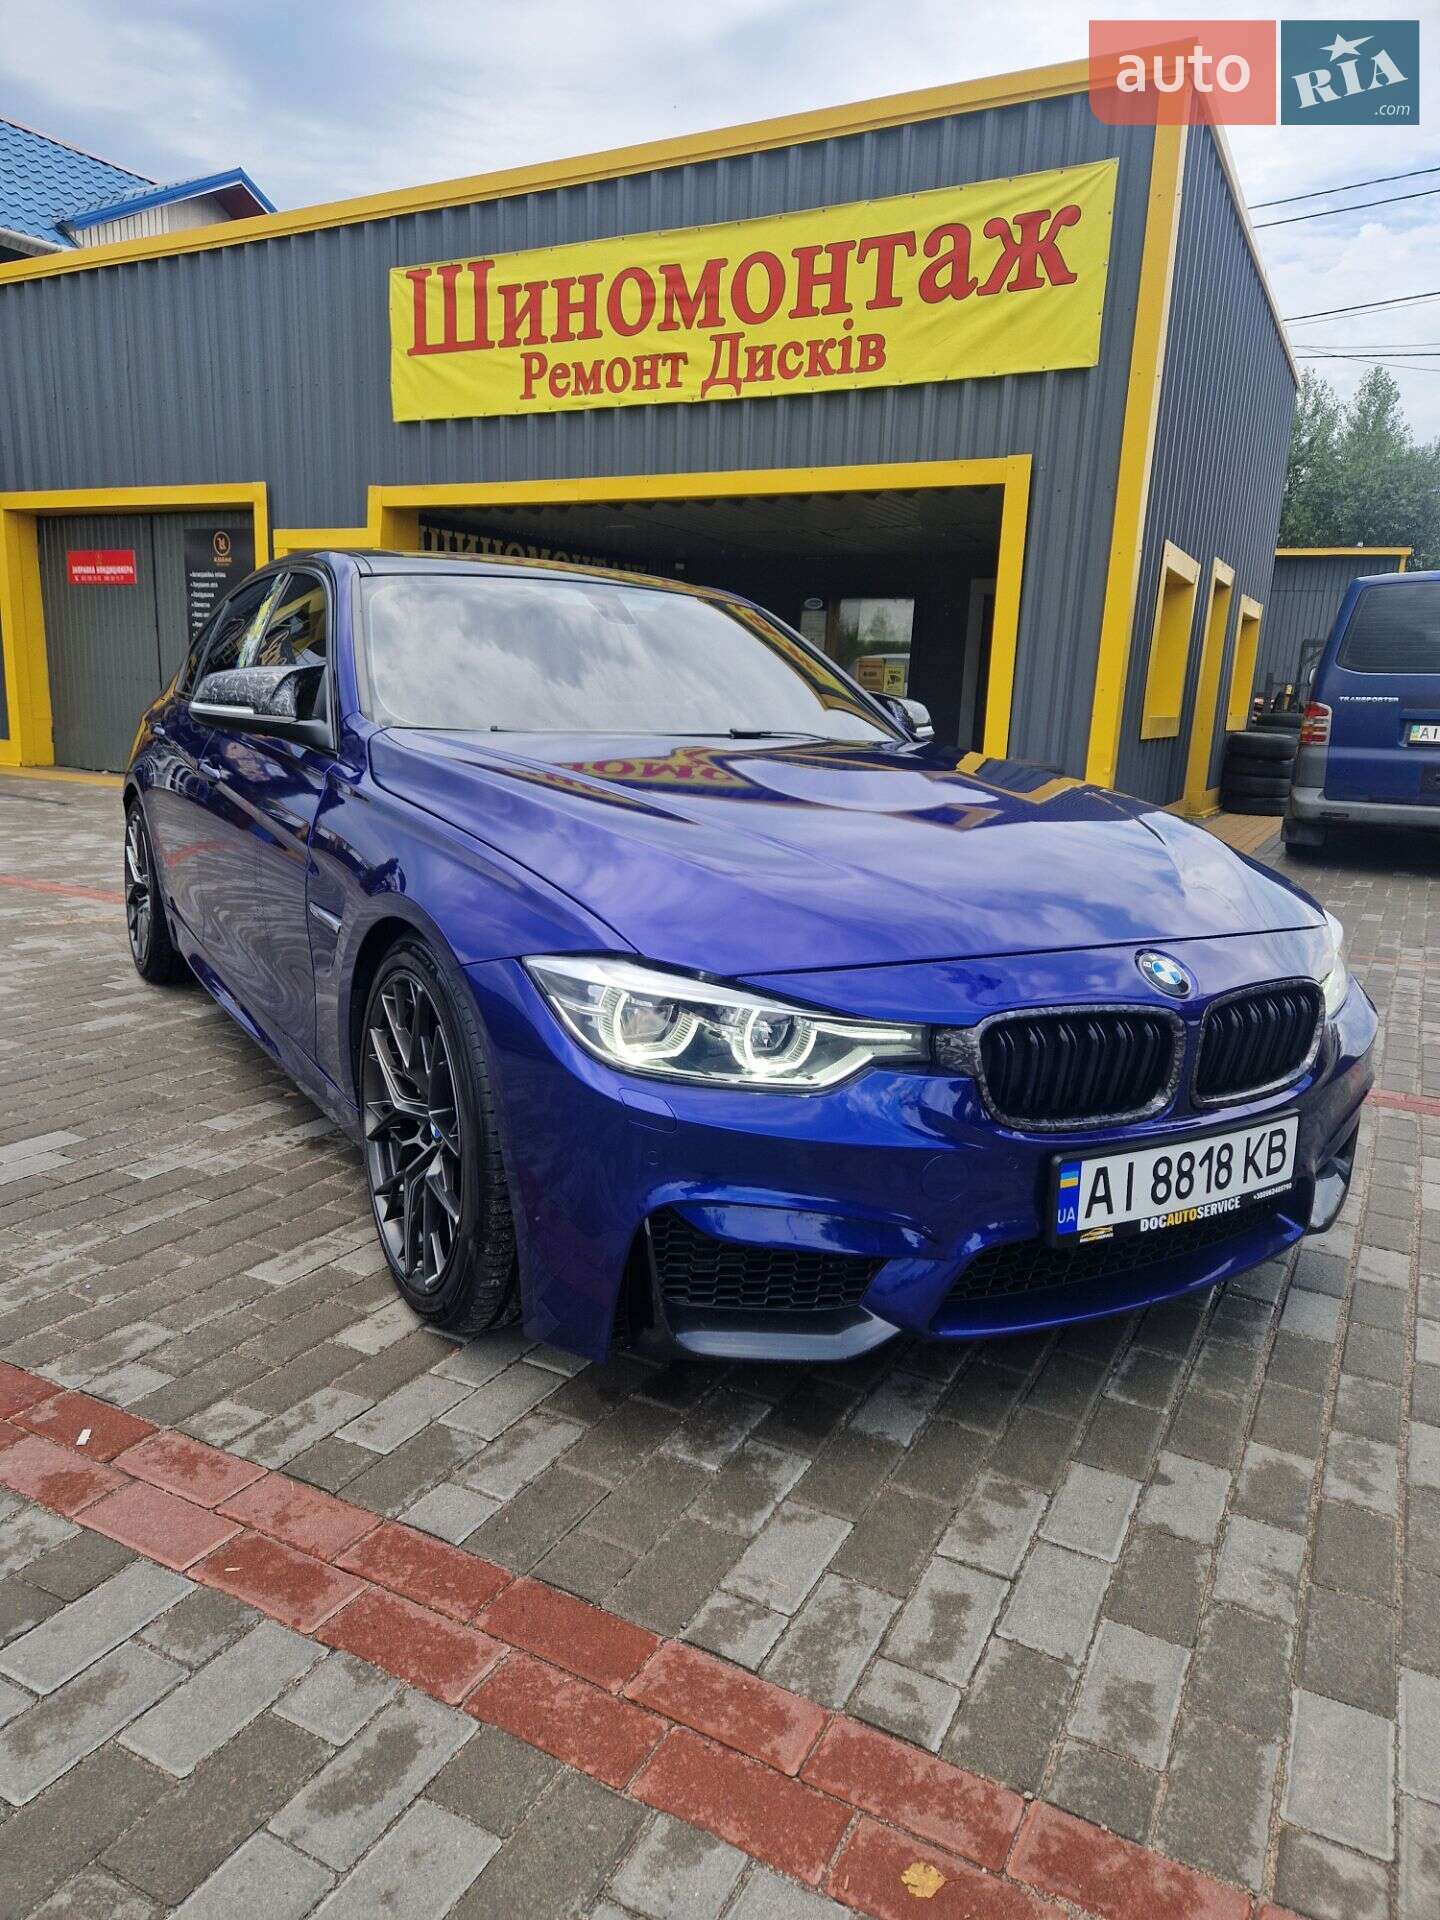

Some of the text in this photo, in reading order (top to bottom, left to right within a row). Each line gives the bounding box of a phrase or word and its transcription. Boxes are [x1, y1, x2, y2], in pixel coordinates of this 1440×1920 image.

[406, 204, 1082, 356] Шиномонтаж
[519, 319, 886, 400] Ремонт Дисків
[1420, 727, 1438, 739] AI
[1084, 1127, 1287, 1219] AI 8818 KB
[1057, 1206, 1076, 1224] UA
[1139, 1195, 1241, 1233] DOCAUTOSERVICE
